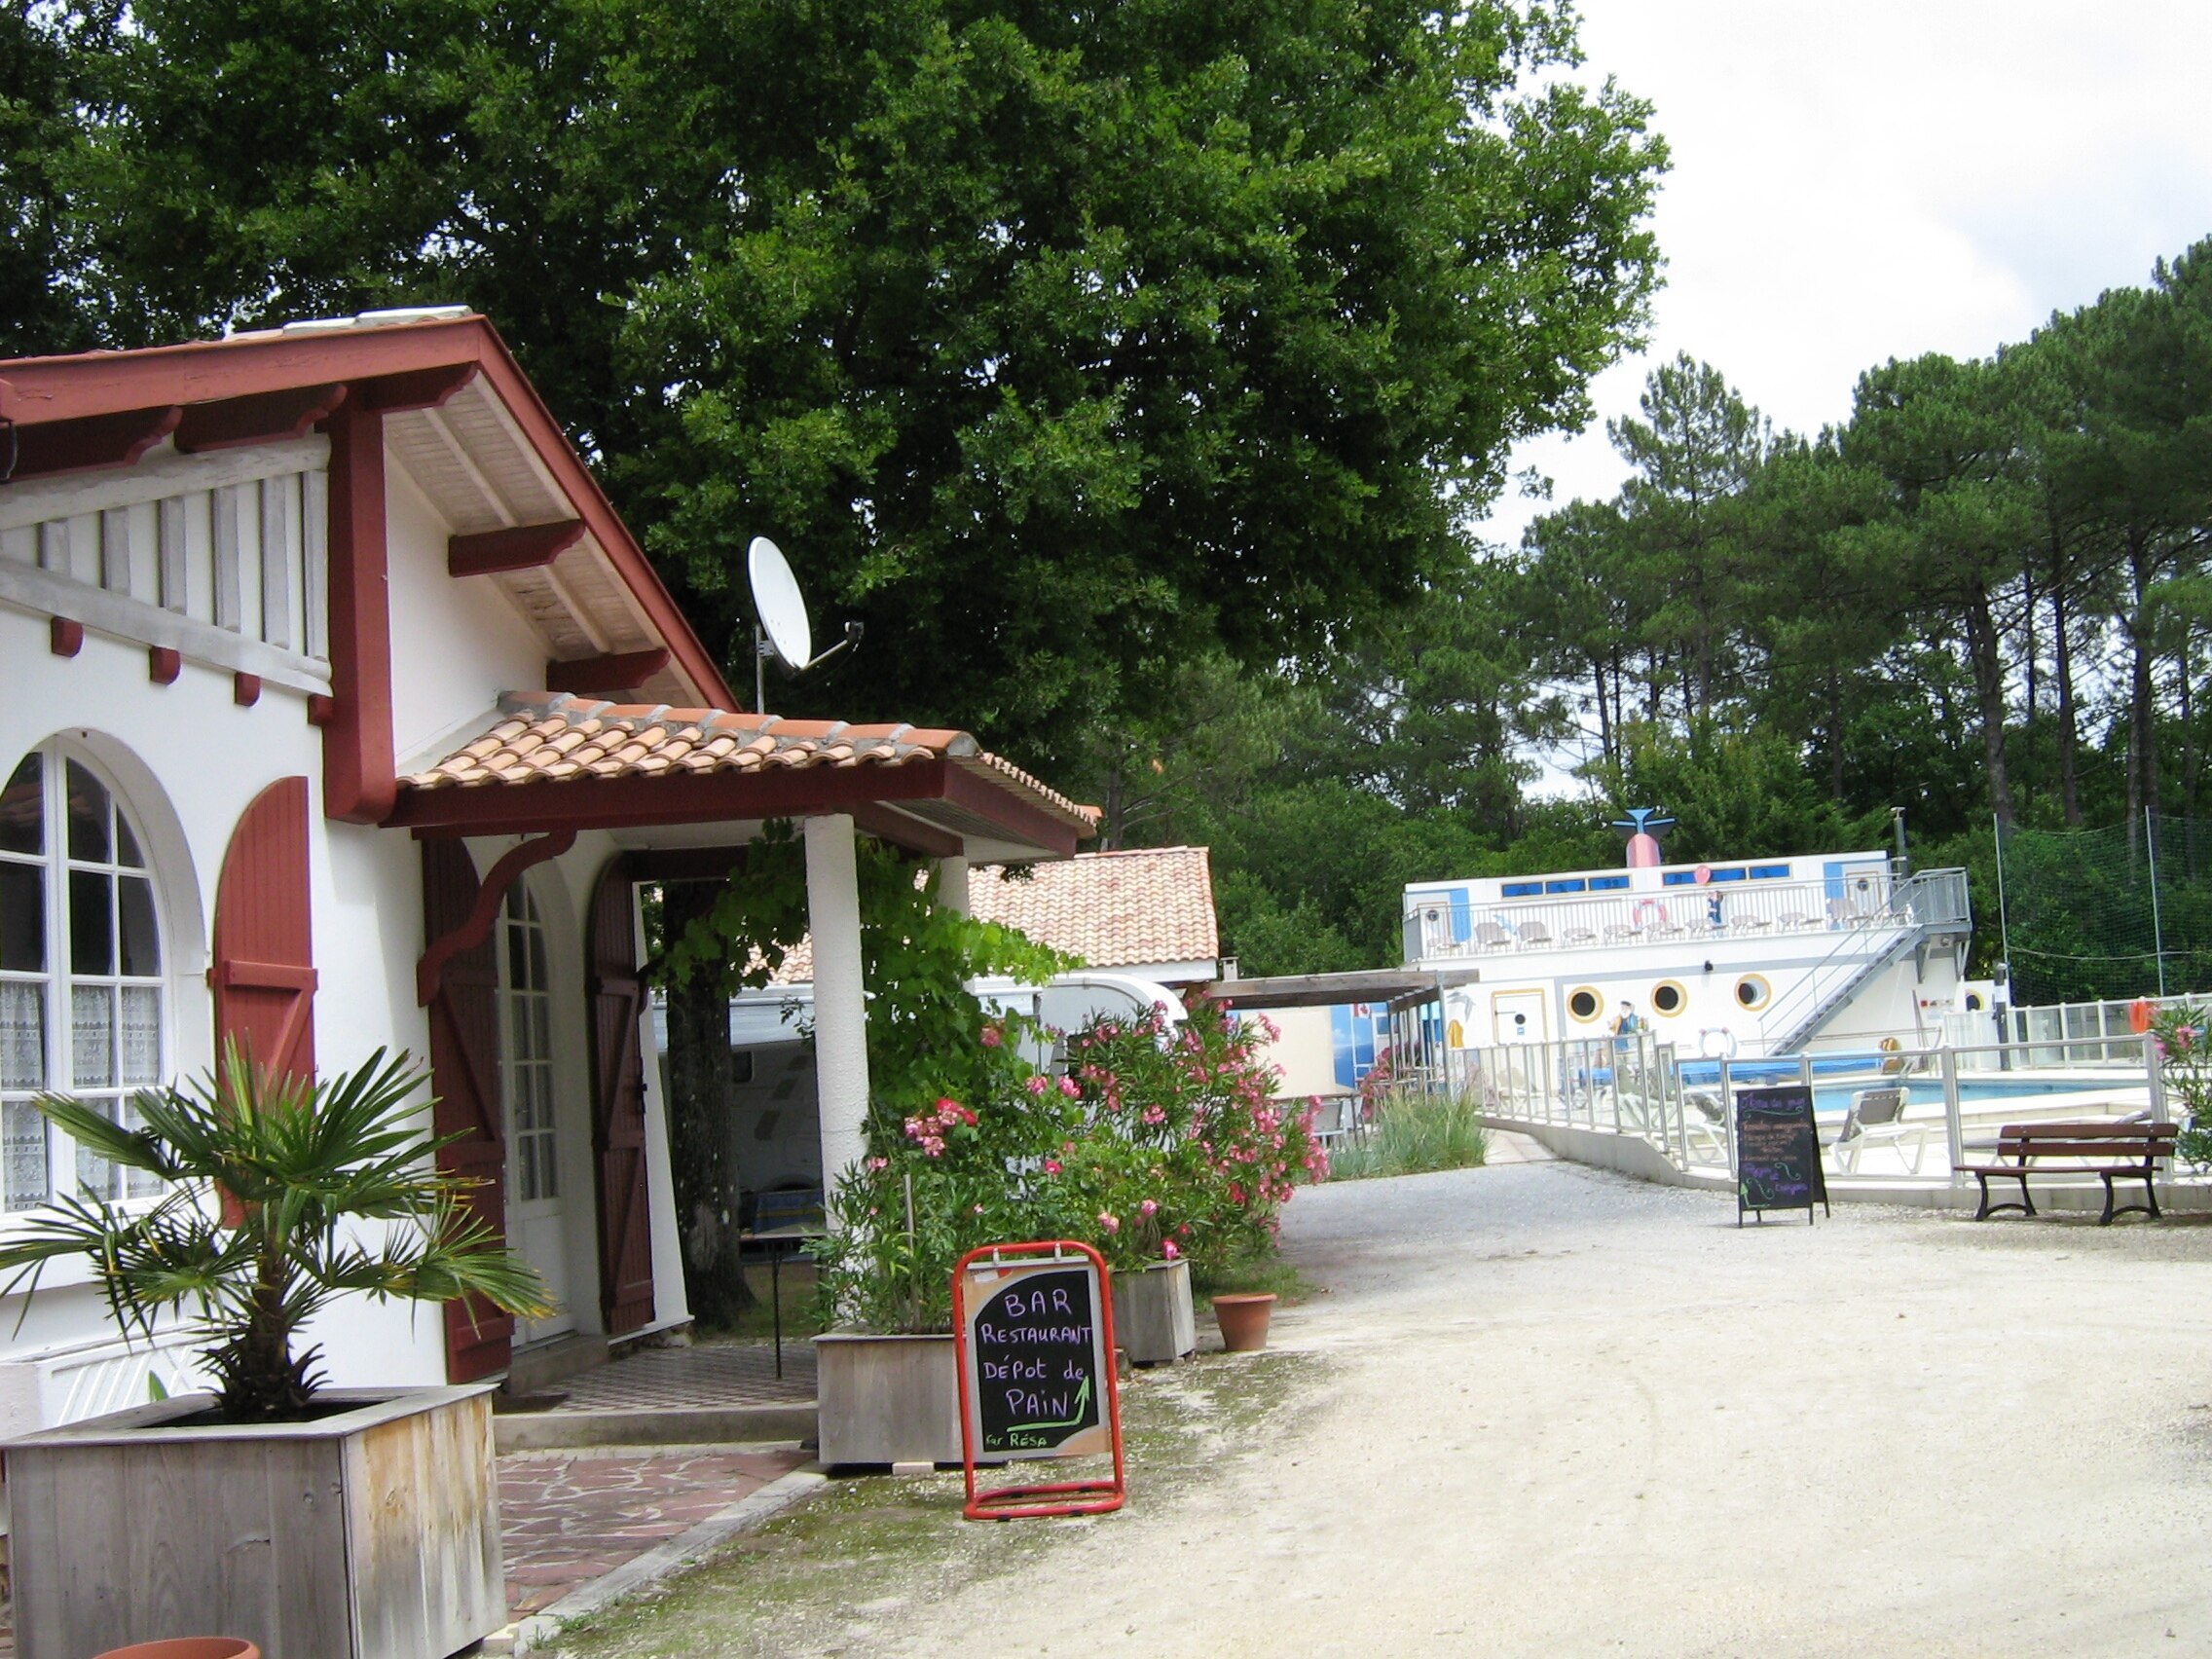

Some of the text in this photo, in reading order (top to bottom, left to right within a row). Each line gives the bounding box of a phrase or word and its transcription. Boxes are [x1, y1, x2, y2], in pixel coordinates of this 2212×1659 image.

[1005, 1288, 1072, 1316] BAR
[980, 1323, 1091, 1344] RESTAURANT
[1063, 1359, 1085, 1381] de
